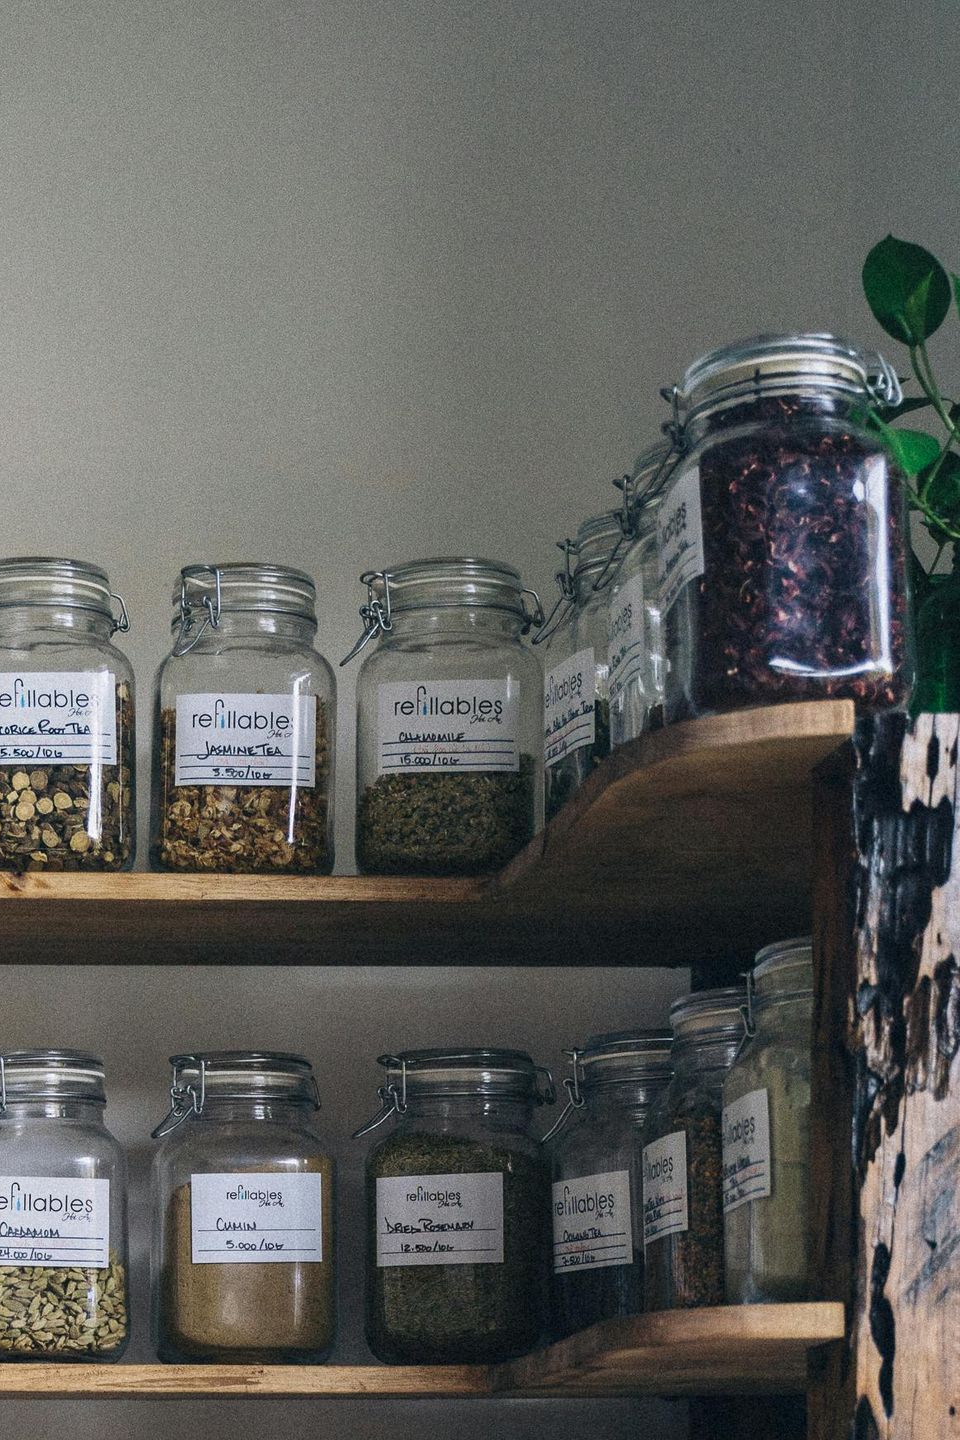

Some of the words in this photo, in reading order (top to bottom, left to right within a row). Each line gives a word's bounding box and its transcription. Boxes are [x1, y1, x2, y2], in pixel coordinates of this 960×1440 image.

[394, 686, 503, 716] refillables
[38, 719, 66, 735] ROOT
[66, 722, 92, 735] TEA
[399, 732, 465, 743] CHAMOMILE
[197, 741, 257, 760] JASMINE
[256, 743, 283, 756] TEA
[226, 1184, 283, 1202] refillables
[406, 1186, 462, 1202] refillables
[0, 1221, 60, 1239] CARDAMOM
[216, 1217, 257, 1232] CUMIN
